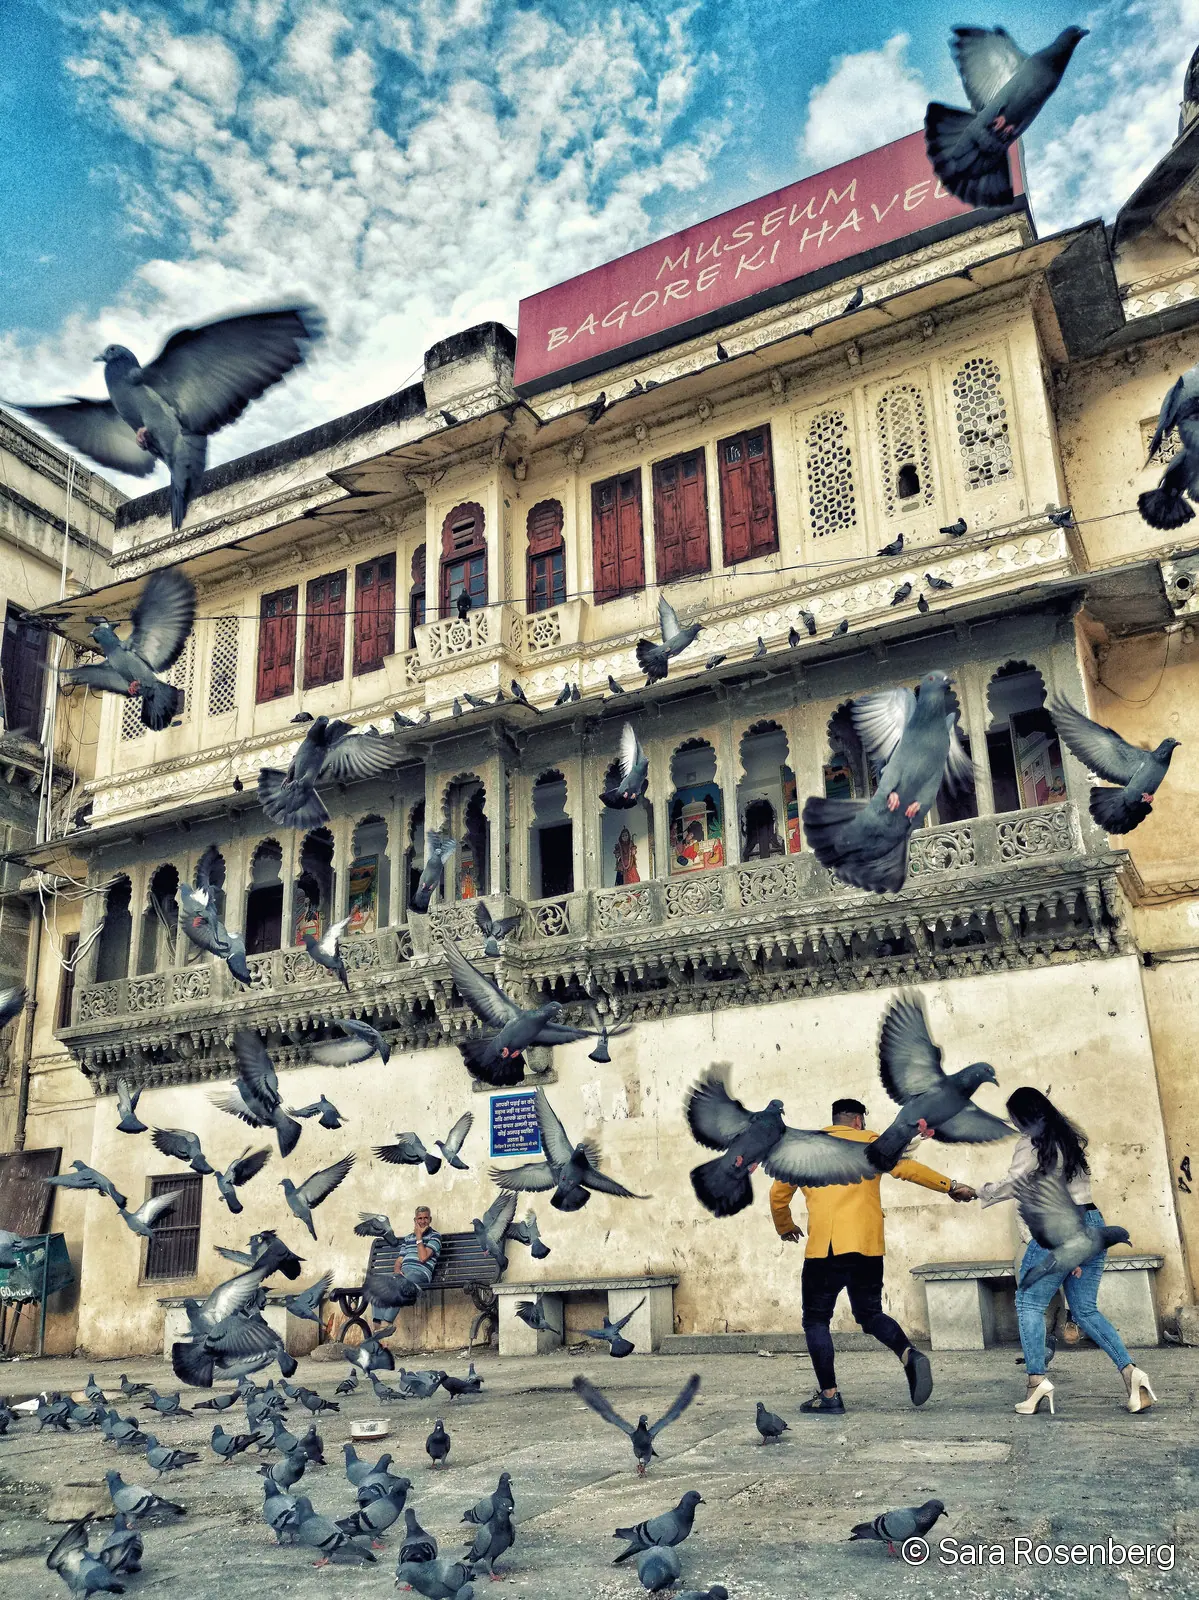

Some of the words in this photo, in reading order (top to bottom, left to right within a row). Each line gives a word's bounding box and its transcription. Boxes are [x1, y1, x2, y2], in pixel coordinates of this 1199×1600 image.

[545, 263, 721, 352] BAGORE
[734, 239, 779, 280] KI
[798, 179, 950, 254] HAVEL
[655, 178, 858, 281] MUSEUM
